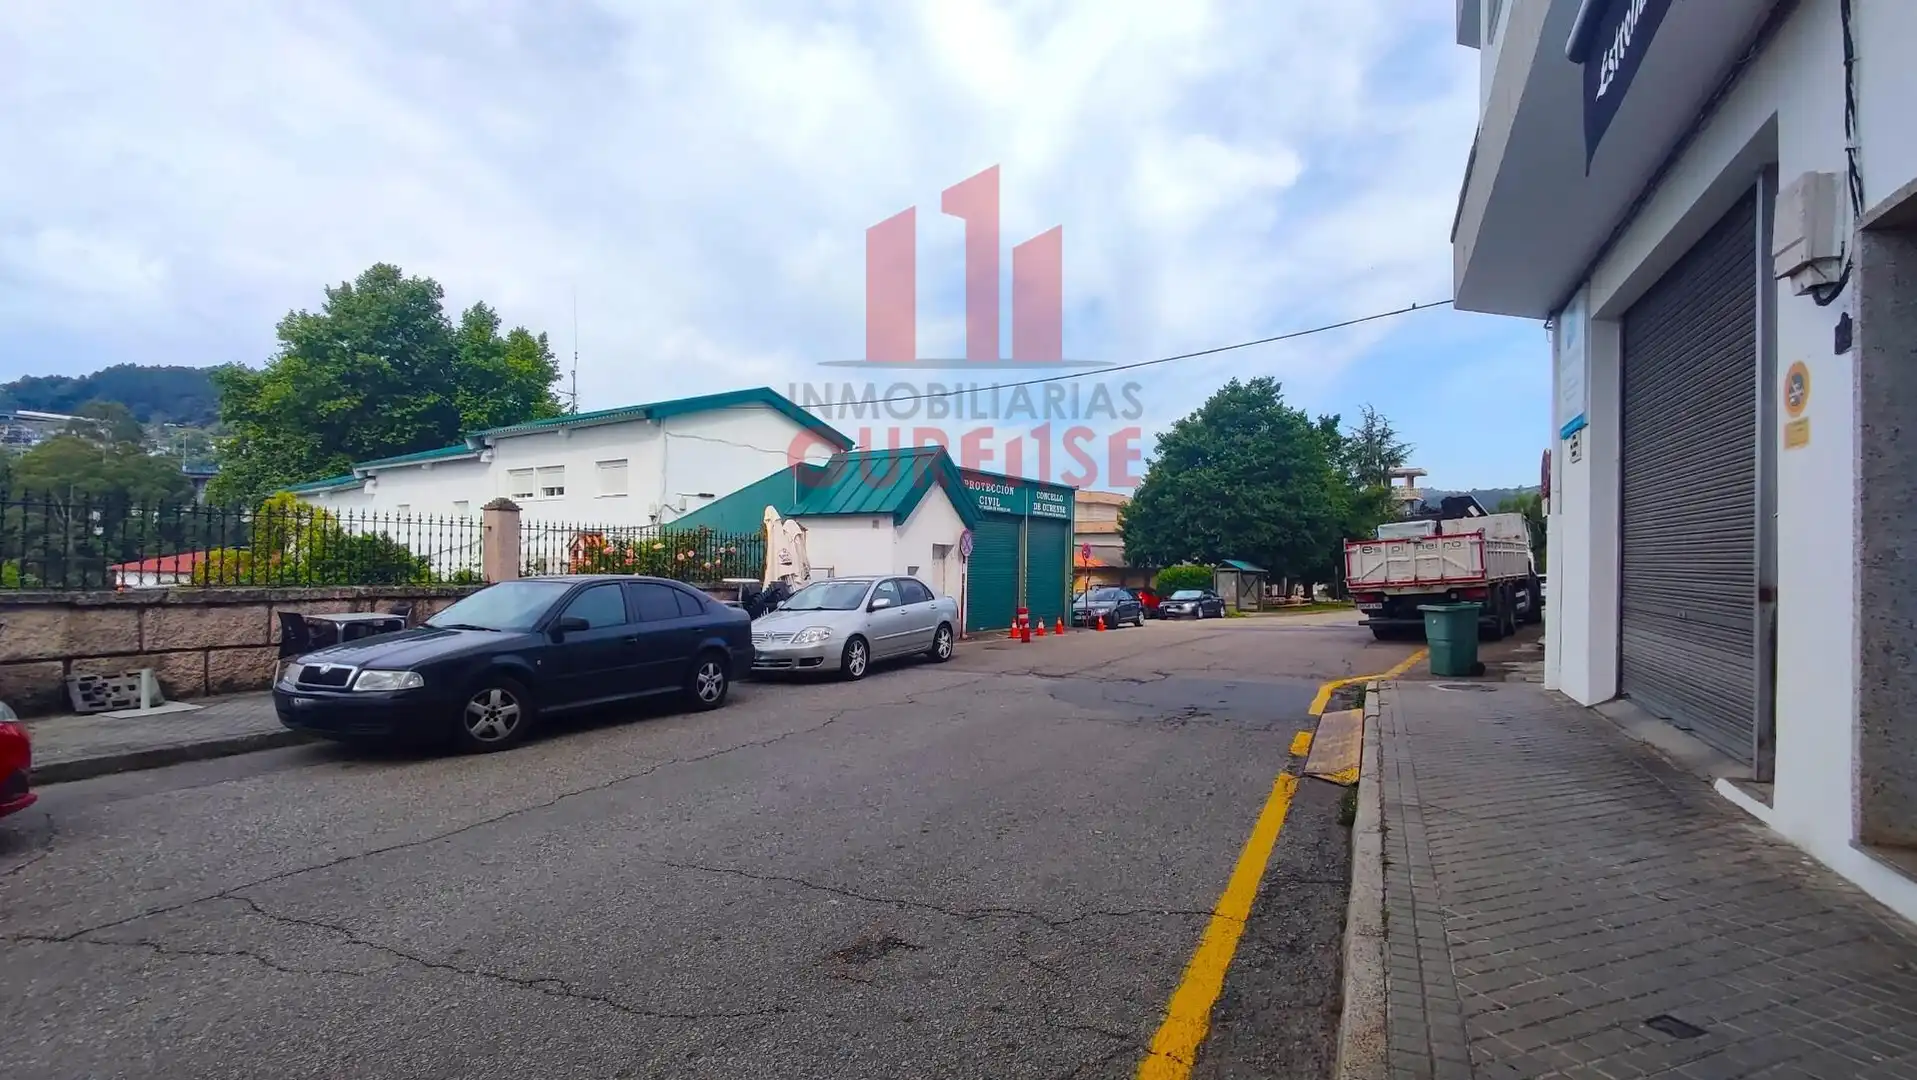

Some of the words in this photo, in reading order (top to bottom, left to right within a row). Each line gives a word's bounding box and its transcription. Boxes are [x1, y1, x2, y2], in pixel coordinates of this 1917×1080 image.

[963, 479, 1015, 496] PROTECCIÓN
[979, 495, 1001, 507] CIVIL
[1036, 491, 1064, 502] CONCELLO
[1033, 502, 1041, 511] DE
